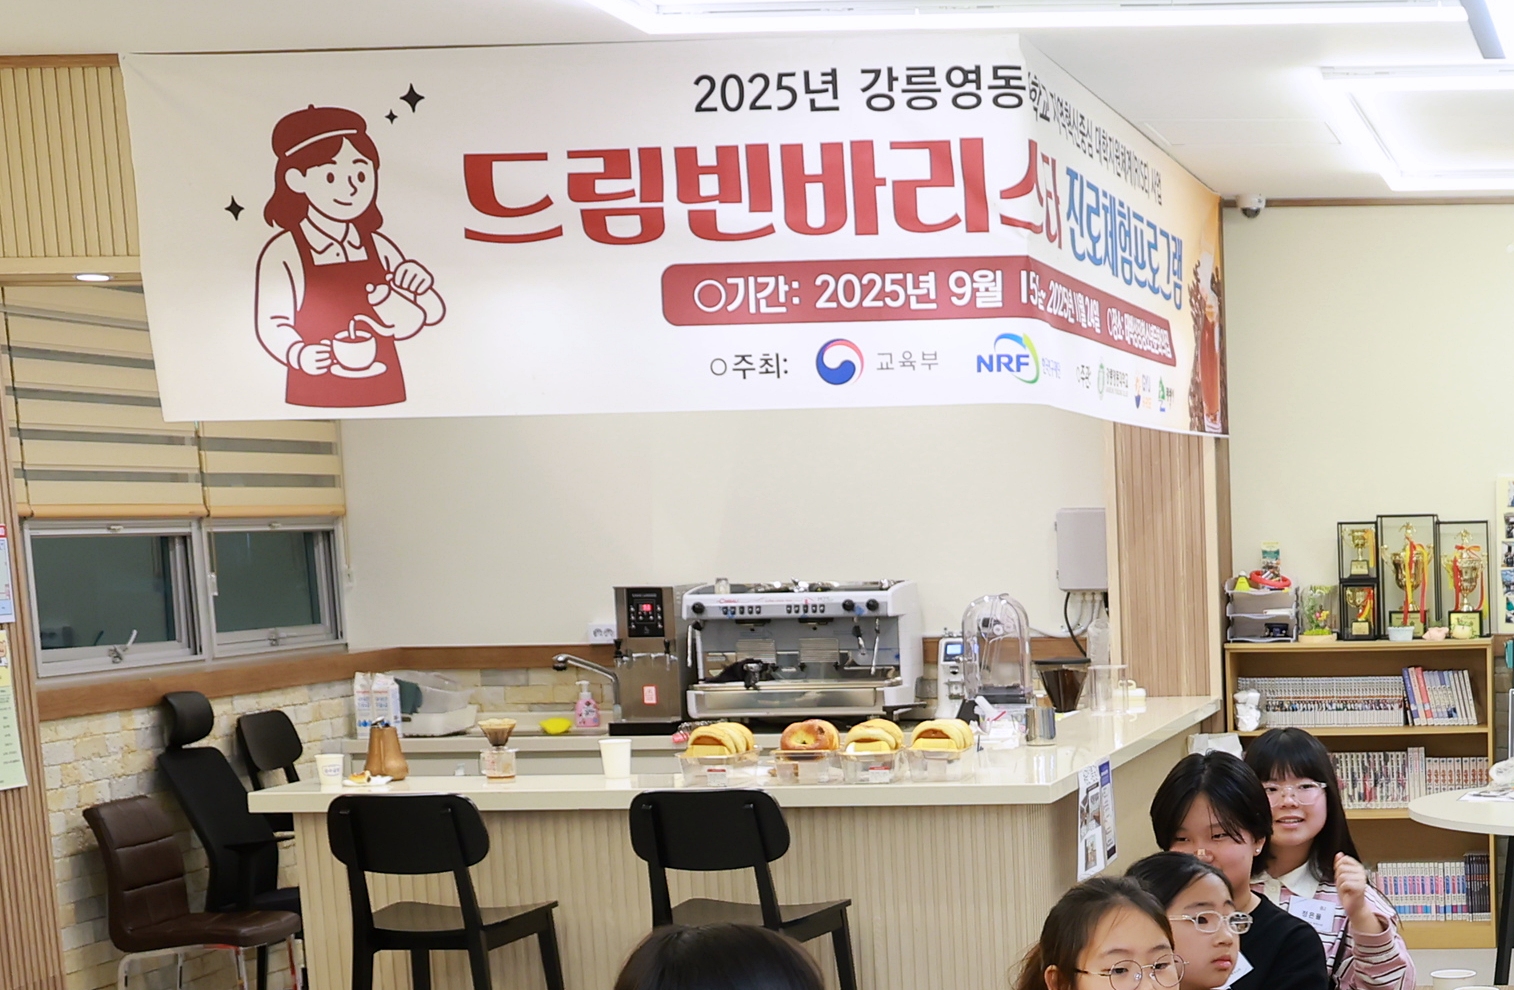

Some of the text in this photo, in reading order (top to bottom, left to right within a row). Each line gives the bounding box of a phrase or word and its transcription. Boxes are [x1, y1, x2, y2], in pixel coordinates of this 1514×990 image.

[693, 67, 840, 113] 2025년
[463, 137, 1183, 310] 드림빈바리스타 진로체험프로그램
[813, 271, 938, 311] 2025년
[948, 269, 1004, 310] 9월
[876, 350, 939, 372] 교육부
[976, 353, 1030, 374] NRF
